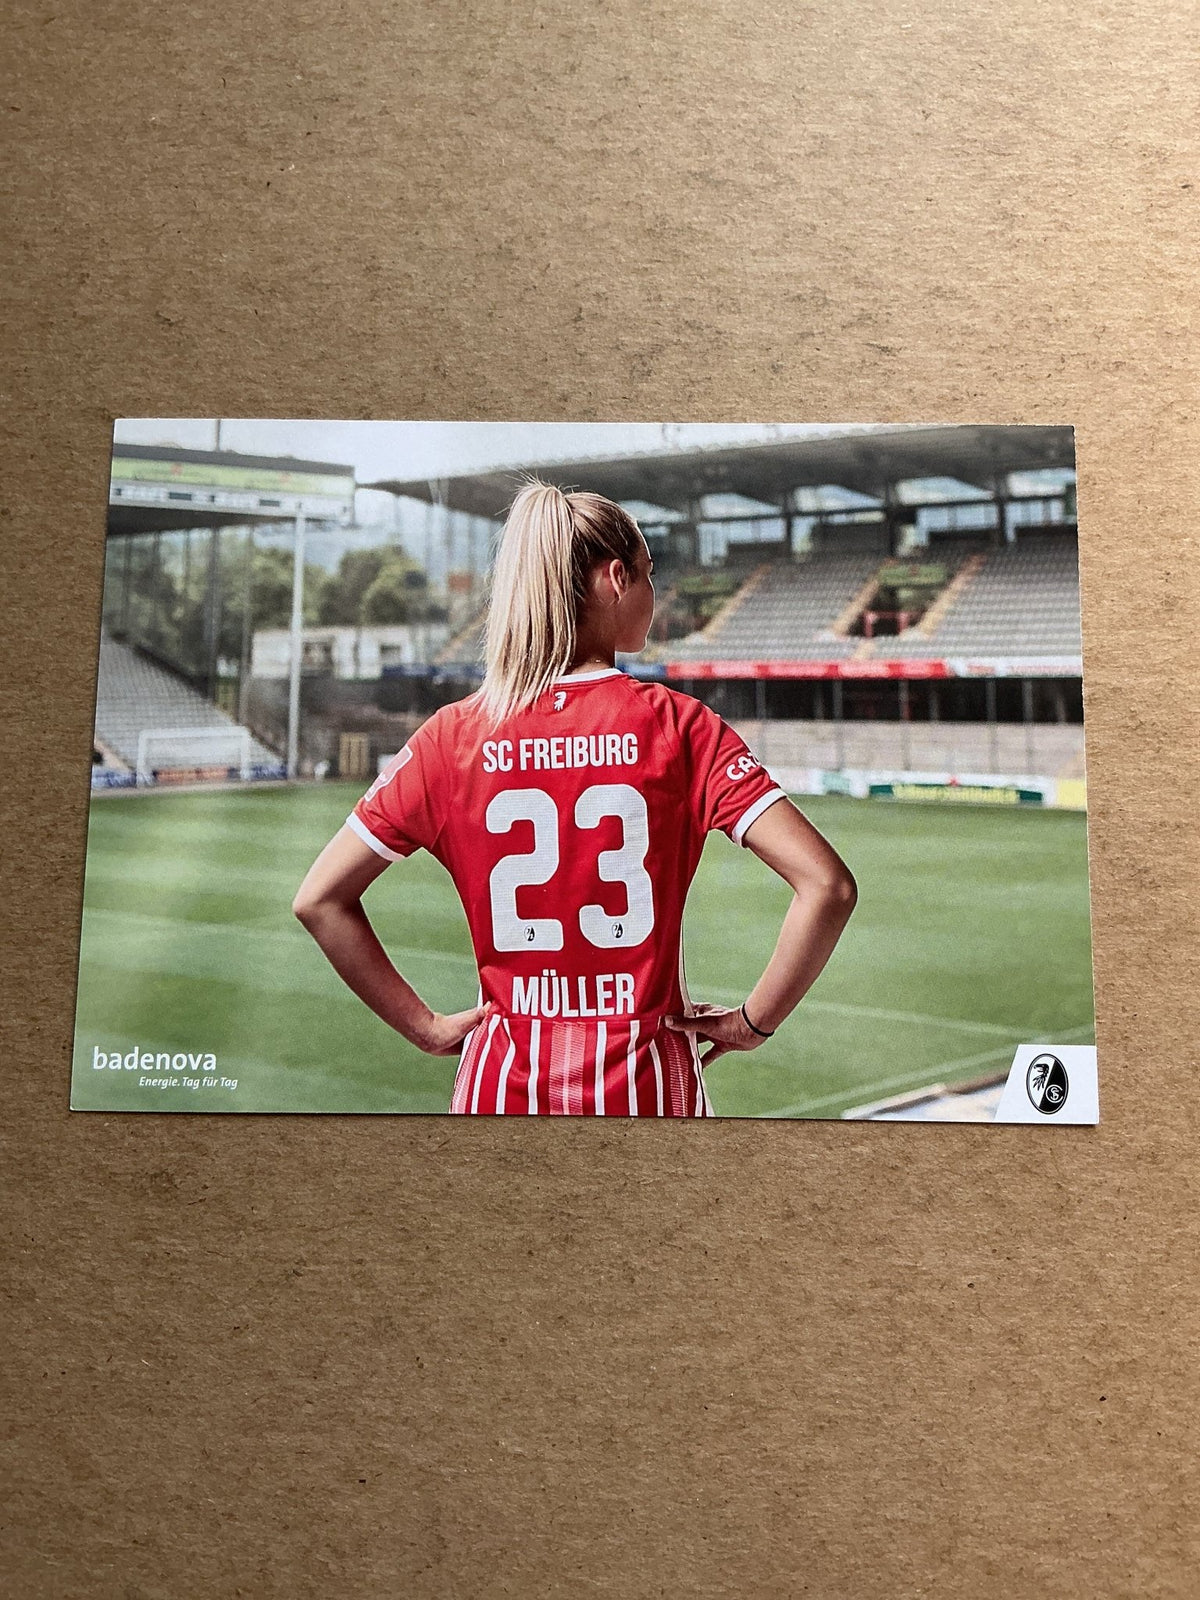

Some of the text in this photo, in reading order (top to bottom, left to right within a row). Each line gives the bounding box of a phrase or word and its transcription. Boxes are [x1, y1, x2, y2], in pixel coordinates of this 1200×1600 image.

[482, 733, 638, 773] SC FREIBURG
[485, 783, 655, 952] 23
[511, 968, 635, 1018] MÜLLER
[93, 1045, 217, 1071] badenova
[138, 1076, 238, 1090] Energie. Tag für Tag
